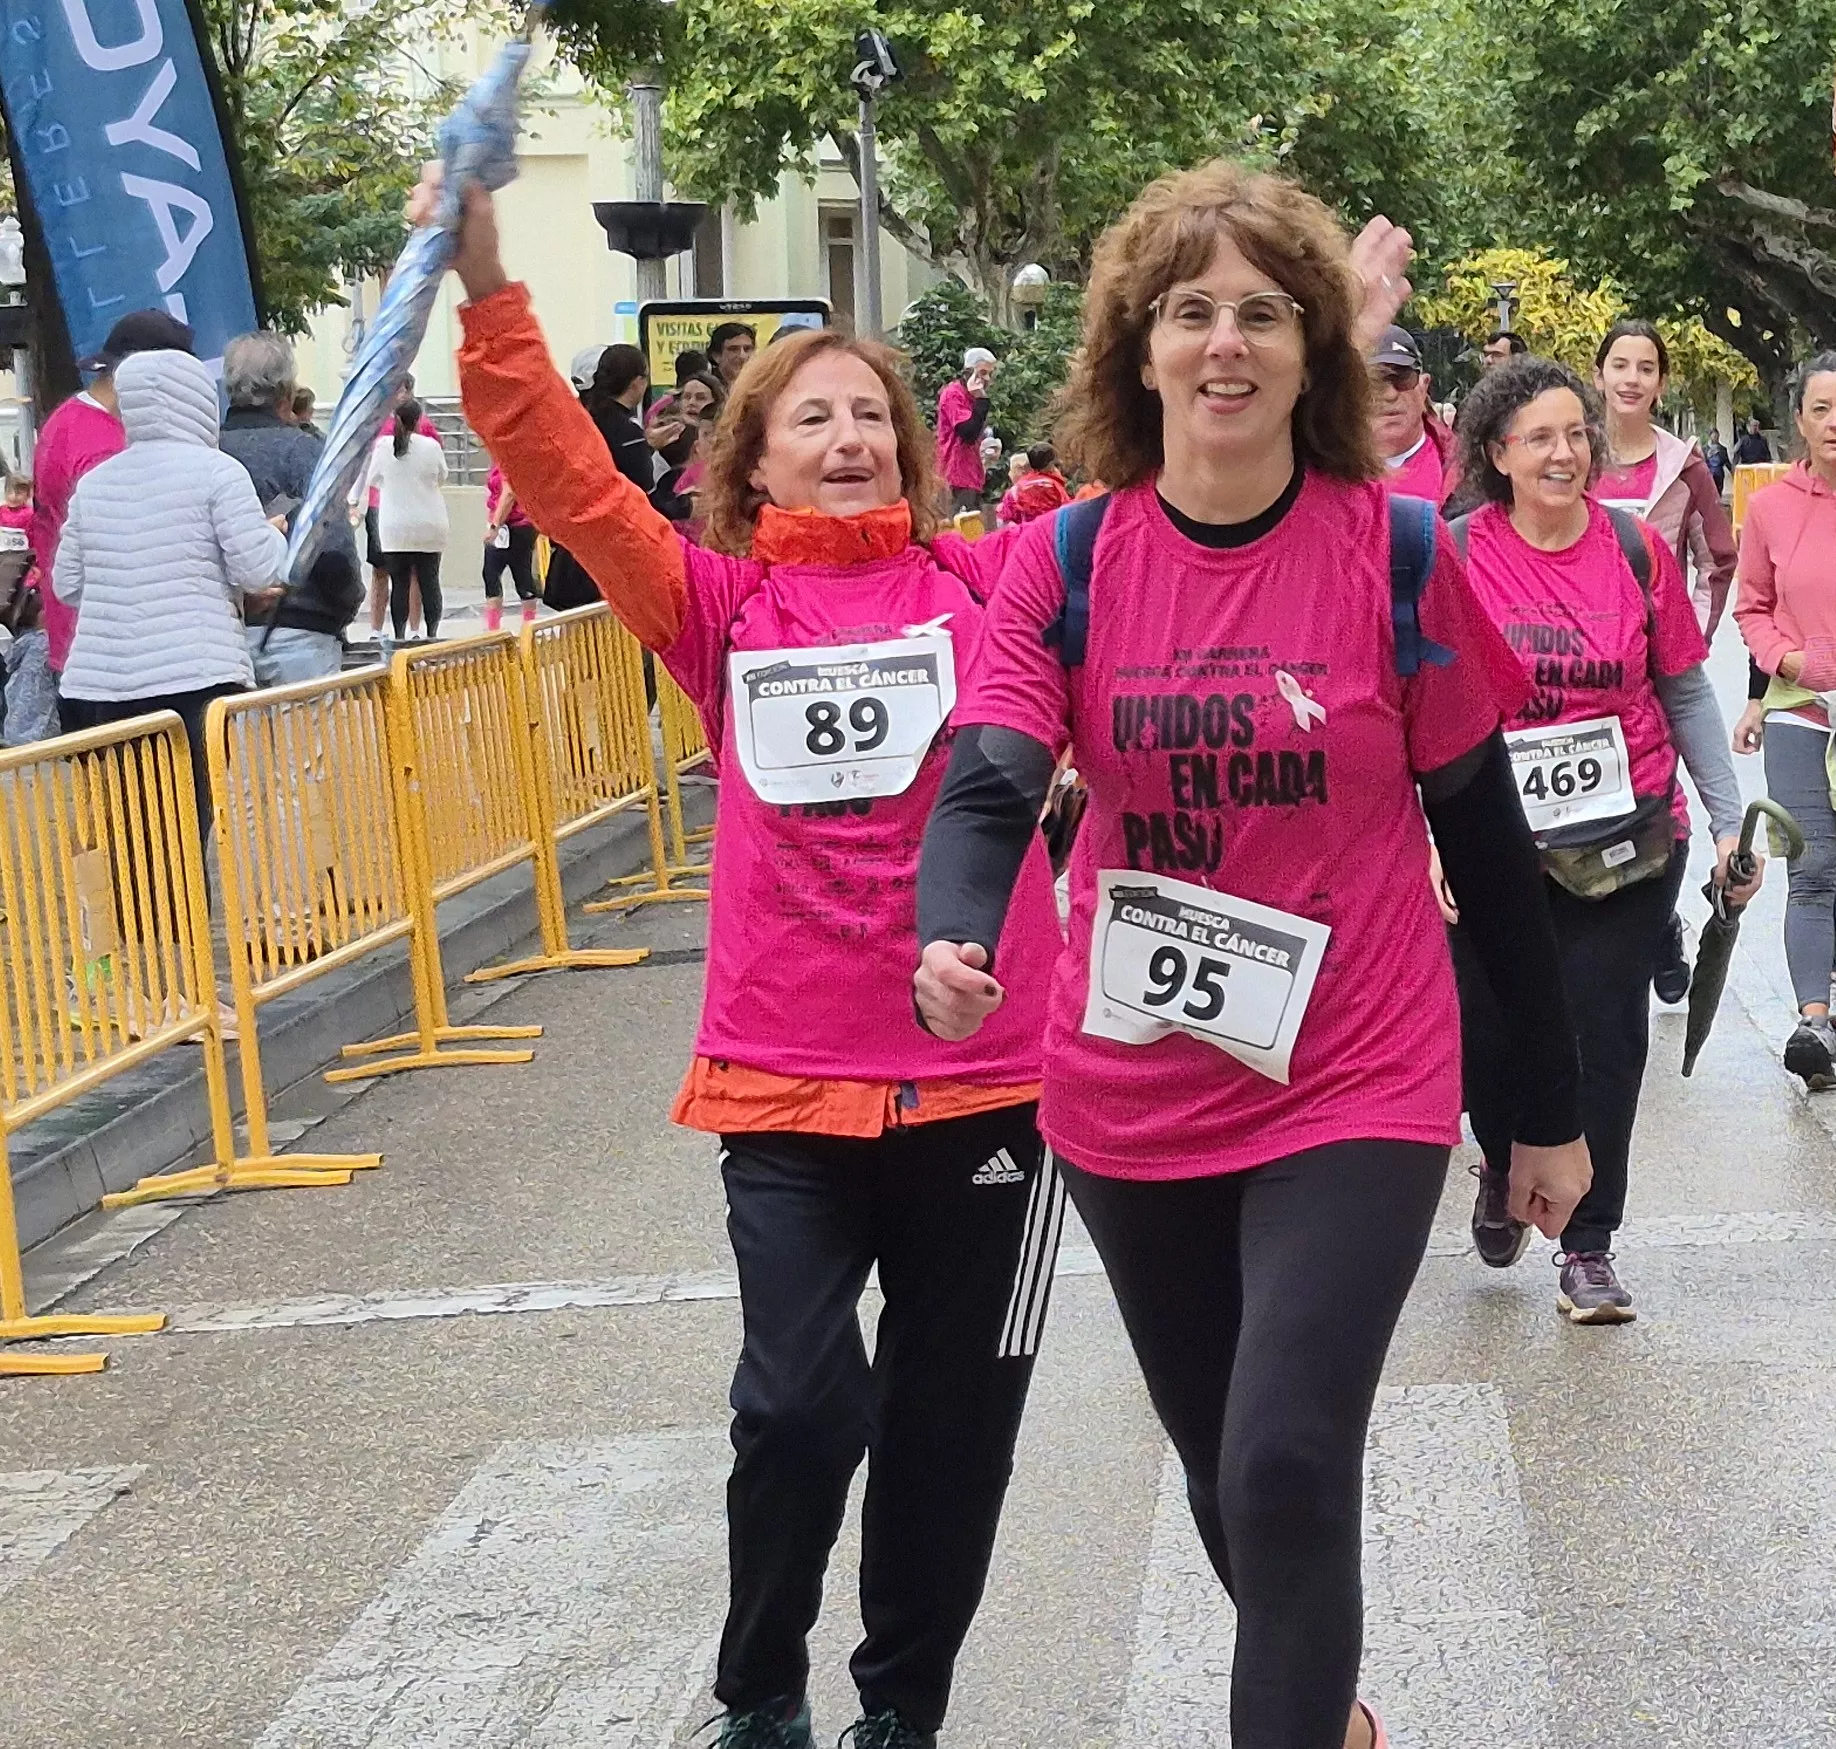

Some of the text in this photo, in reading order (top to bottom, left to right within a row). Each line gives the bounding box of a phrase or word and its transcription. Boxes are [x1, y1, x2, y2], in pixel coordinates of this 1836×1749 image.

[656, 322, 702, 337] VISITAS
[758, 669, 930, 697] CONTRA EL CÁNCER
[817, 662, 870, 677] HUESCA
[805, 696, 890, 756] 89
[1112, 692, 1256, 752] UNIDOS
[1169, 750, 1328, 809] EN CADA
[1522, 757, 1603, 801] 469
[1120, 903, 1291, 968] CONTRA EL CÁNCER
[1179, 905, 1230, 932] HUESCA
[1142, 945, 1231, 1021] 95
